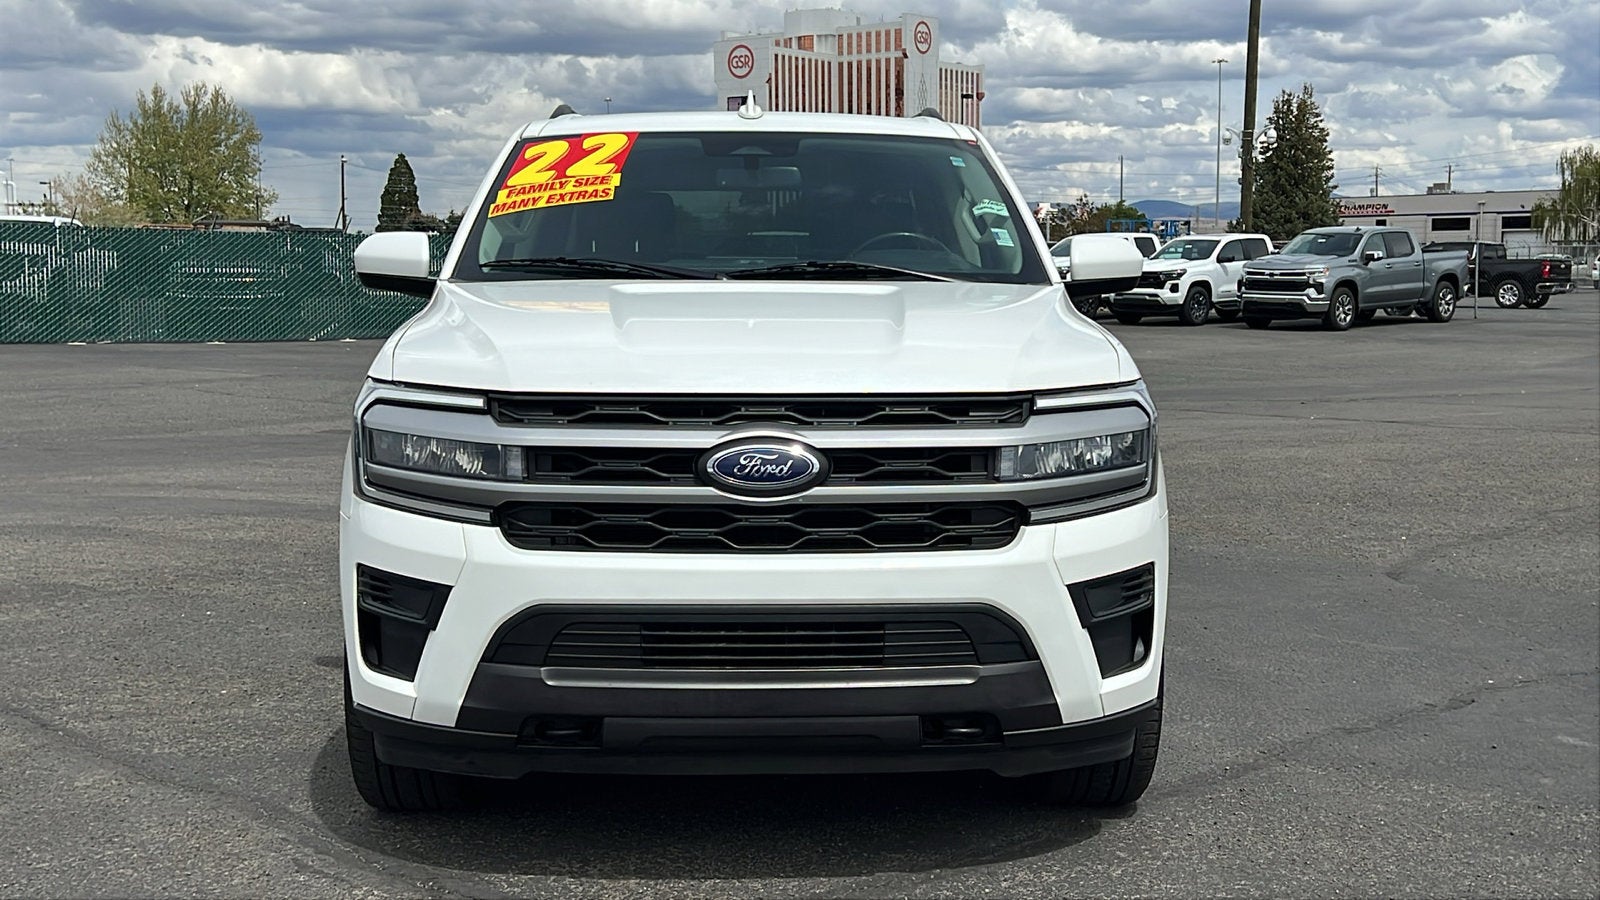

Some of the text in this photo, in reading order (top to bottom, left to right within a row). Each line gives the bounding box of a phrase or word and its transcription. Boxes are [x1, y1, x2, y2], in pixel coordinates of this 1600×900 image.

[916, 30, 929, 45] GSR
[731, 54, 750, 69] GSR
[506, 133, 630, 186] 22
[506, 175, 612, 198] FAMILY SIZE
[490, 188, 611, 214] MANY EXTRAS
[733, 453, 794, 477] Ford
